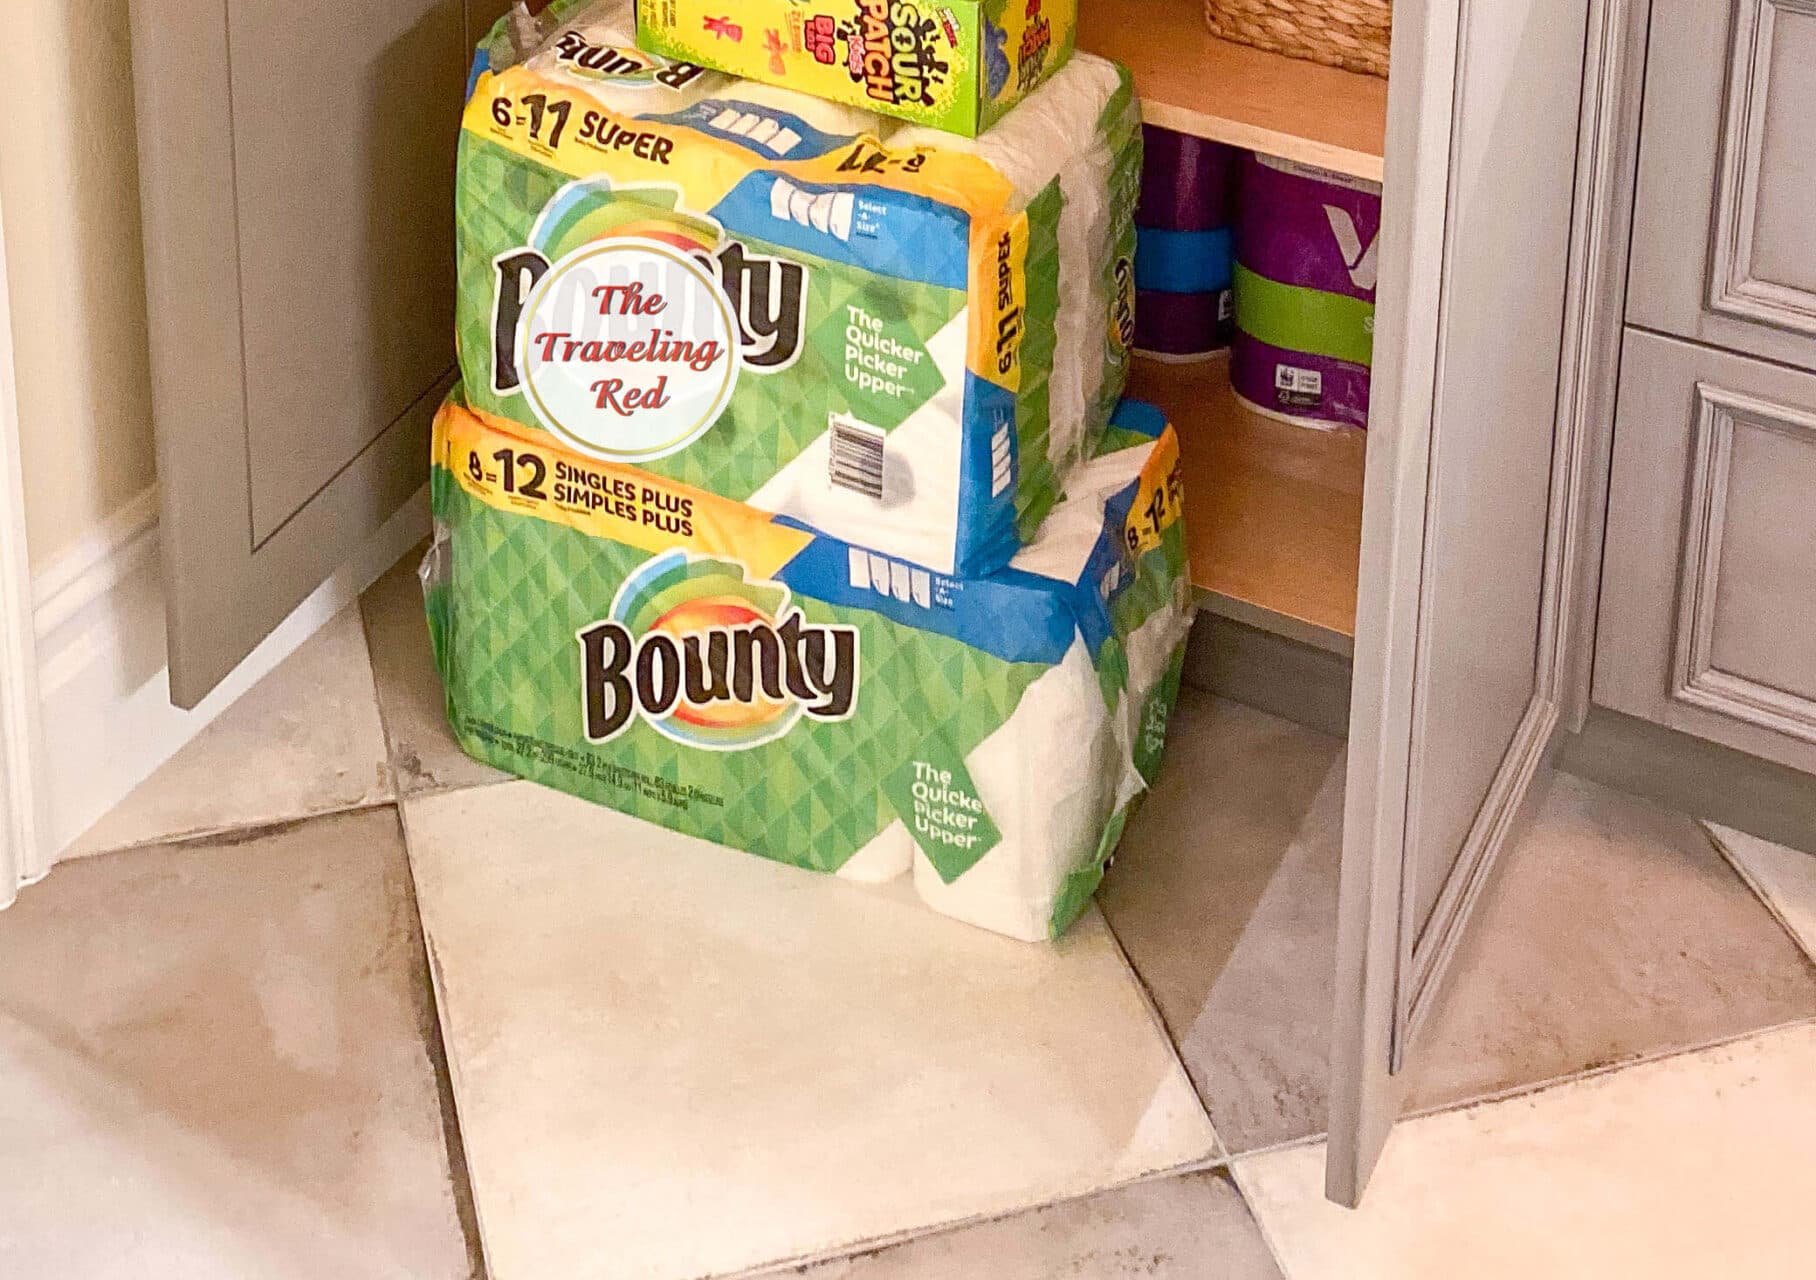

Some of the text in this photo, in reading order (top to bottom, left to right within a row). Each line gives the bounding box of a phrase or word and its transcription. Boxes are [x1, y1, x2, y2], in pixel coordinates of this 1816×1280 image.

[814, 15, 836, 65] BIG
[890, 2, 923, 102] SOUR
[579, 110, 674, 165] SUPER
[858, 200, 887, 215] Select
[847, 304, 883, 332] The
[845, 344, 908, 379] Picker
[846, 325, 925, 365] Quicker
[845, 363, 903, 397] Upper
[555, 461, 637, 501] SINGLES
[641, 487, 694, 518] PLUS
[554, 483, 637, 521] SIMPLES
[642, 509, 694, 537] PLUS
[580, 611, 856, 740] Bounty
[912, 760, 952, 785] The
[914, 799, 978, 830] Picker
[915, 814, 977, 850] Upper
